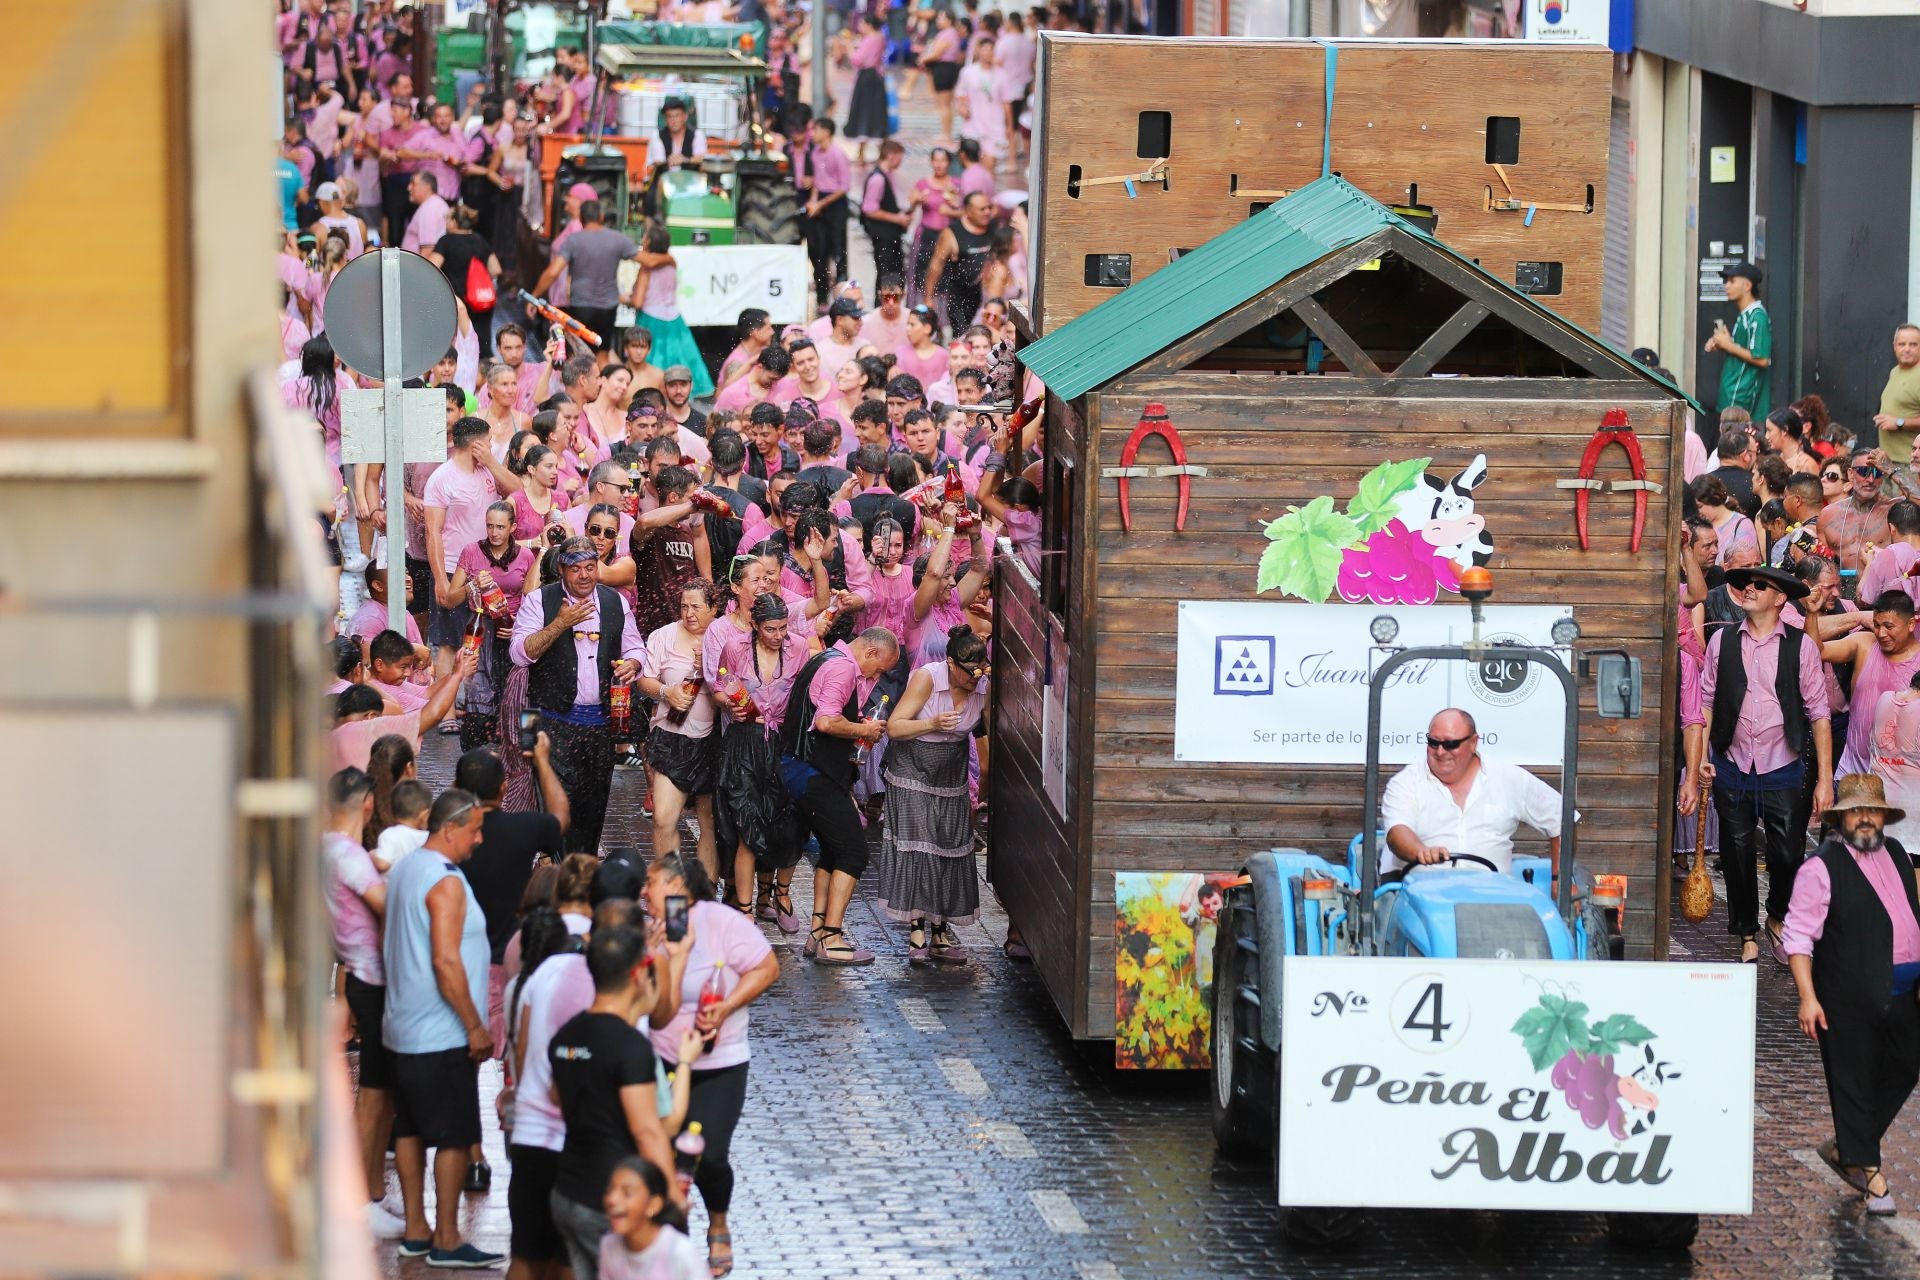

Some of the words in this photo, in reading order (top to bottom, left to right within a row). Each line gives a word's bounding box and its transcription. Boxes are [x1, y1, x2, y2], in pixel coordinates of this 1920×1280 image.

[769, 279, 782, 297] 5
[1285, 650, 1369, 688] Juan
[1484, 694, 1516, 704] BODEGAS
[1253, 729, 1276, 744] Ser
[1281, 731, 1322, 746] parte
[1325, 729, 1345, 744] de
[1349, 730, 1363, 744] lo
[1381, 732, 1411, 746] ejor
[1402, 982, 1453, 1042] 4
[1321, 1064, 1492, 1105] Peña
[1498, 1087, 1551, 1122] El
[1430, 1127, 1674, 1185] Albal
